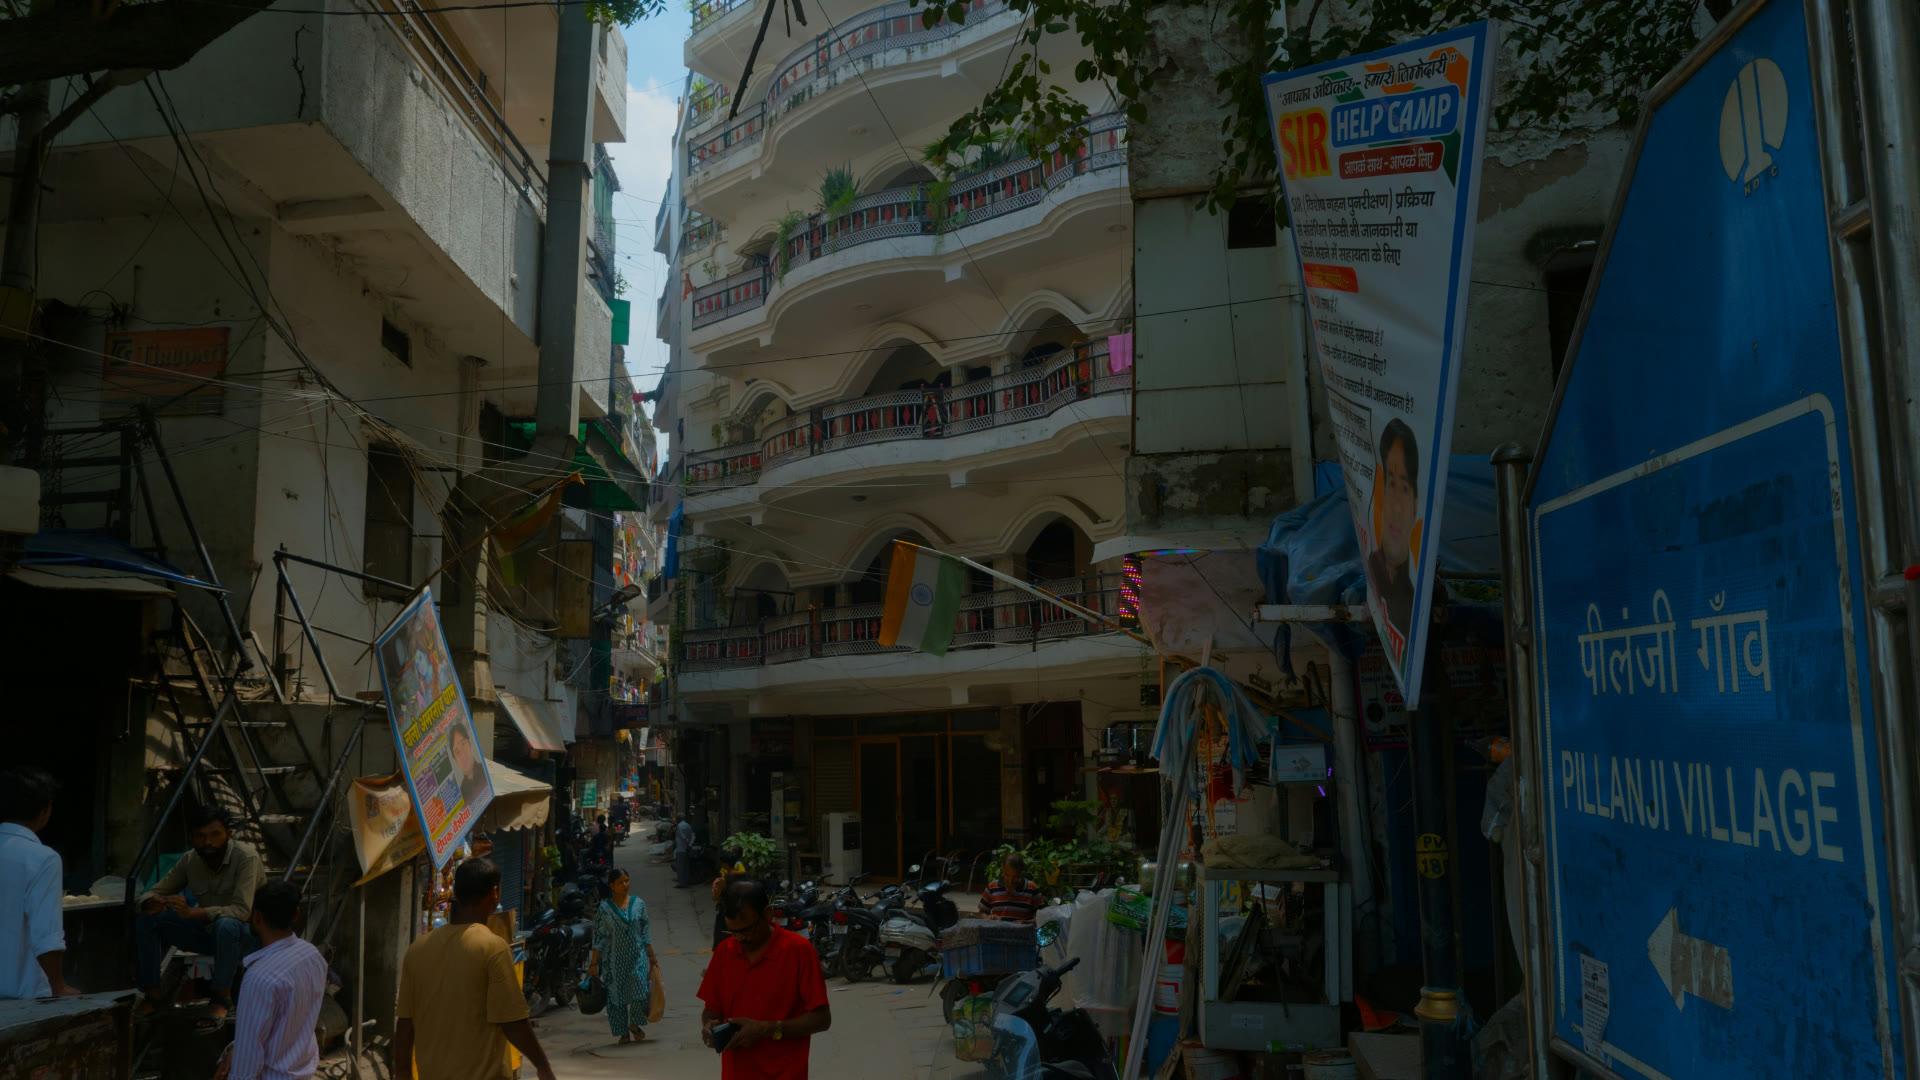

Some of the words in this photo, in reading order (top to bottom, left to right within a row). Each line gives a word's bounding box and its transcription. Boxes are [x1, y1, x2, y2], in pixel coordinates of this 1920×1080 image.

[1279, 111, 1330, 178] SIR
[1336, 104, 1384, 142] HELP
[1387, 92, 1451, 134] CAMP
[1395, 185, 1435, 209] प्रक्रिया
[1339, 246, 1370, 263] सहायता
[1371, 242, 1382, 263] के
[1383, 242, 1401, 266] लिए
[1361, 215, 1403, 238] जानकारी
[1405, 222, 1418, 238] या
[1578, 590, 1678, 695] पीलंजी
[1692, 590, 1771, 693] गाँव
[1561, 750, 1670, 832] PILLANJI
[1673, 760, 1844, 862] VILLAGE
